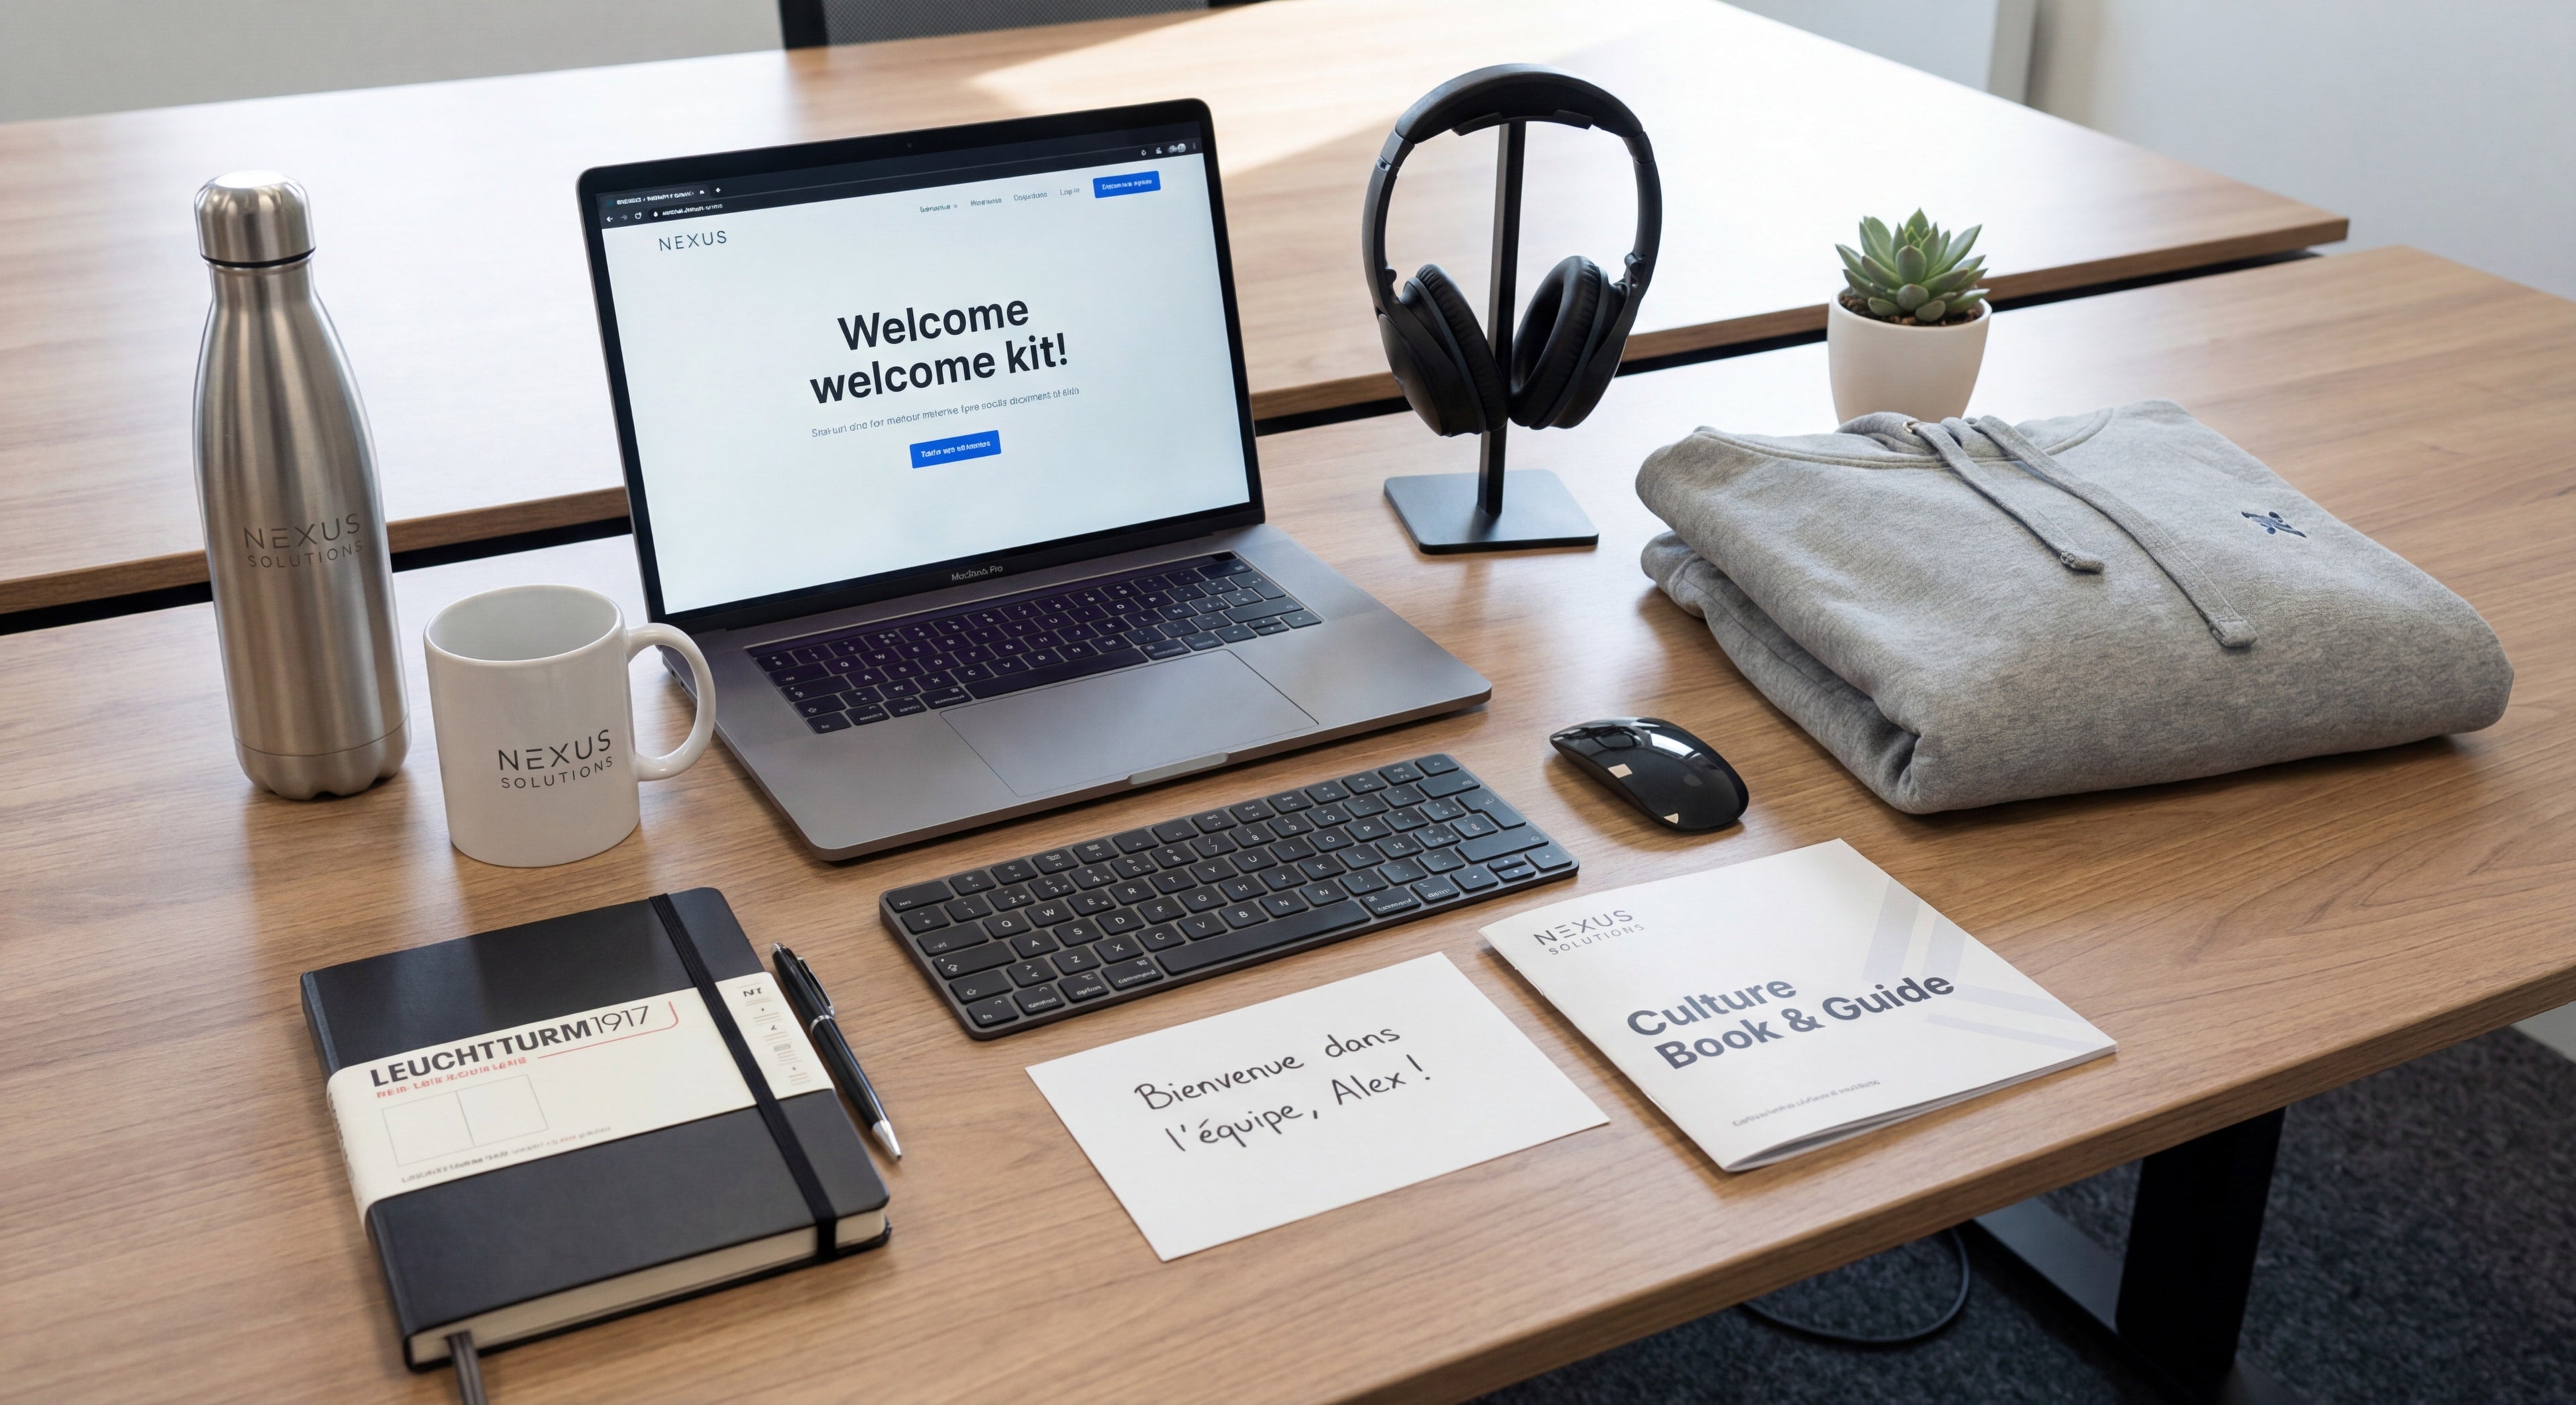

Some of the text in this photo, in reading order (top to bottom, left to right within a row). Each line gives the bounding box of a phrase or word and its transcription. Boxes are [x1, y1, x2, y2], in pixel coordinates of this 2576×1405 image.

[659, 231, 727, 251] NEXUS
[837, 300, 1029, 351] Welcome
[810, 332, 1068, 404] welcome kit!
[244, 513, 360, 549] NEXUS
[248, 540, 363, 569] SOLUTIONS
[498, 729, 611, 771] NEXUS
[501, 756, 613, 789] SOLUTIONS
[1042, 909, 1055, 917] W
[1208, 866, 1216, 874] Y
[1248, 855, 1258, 863] U
[1073, 928, 1083, 936] S
[1115, 917, 1125, 925] D
[1238, 884, 1248, 892] H
[1071, 956, 1081, 964] Z
[1112, 944, 1124, 952] X
[1155, 932, 1165, 940] C
[1197, 921, 1205, 930] V
[1238, 911, 1248, 919] B
[1279, 899, 1289, 907] N
[1534, 909, 1633, 946] NEXUS
[1548, 923, 1645, 956] SOLUTIONS
[1627, 979, 1798, 1037] Culture
[1654, 975, 1955, 1070] Book & Guide
[1134, 1027, 1401, 1110] Bienvenue dans
[1165, 1103, 1320, 1151] l'équipe,
[1331, 1071, 1407, 1105] Alex
